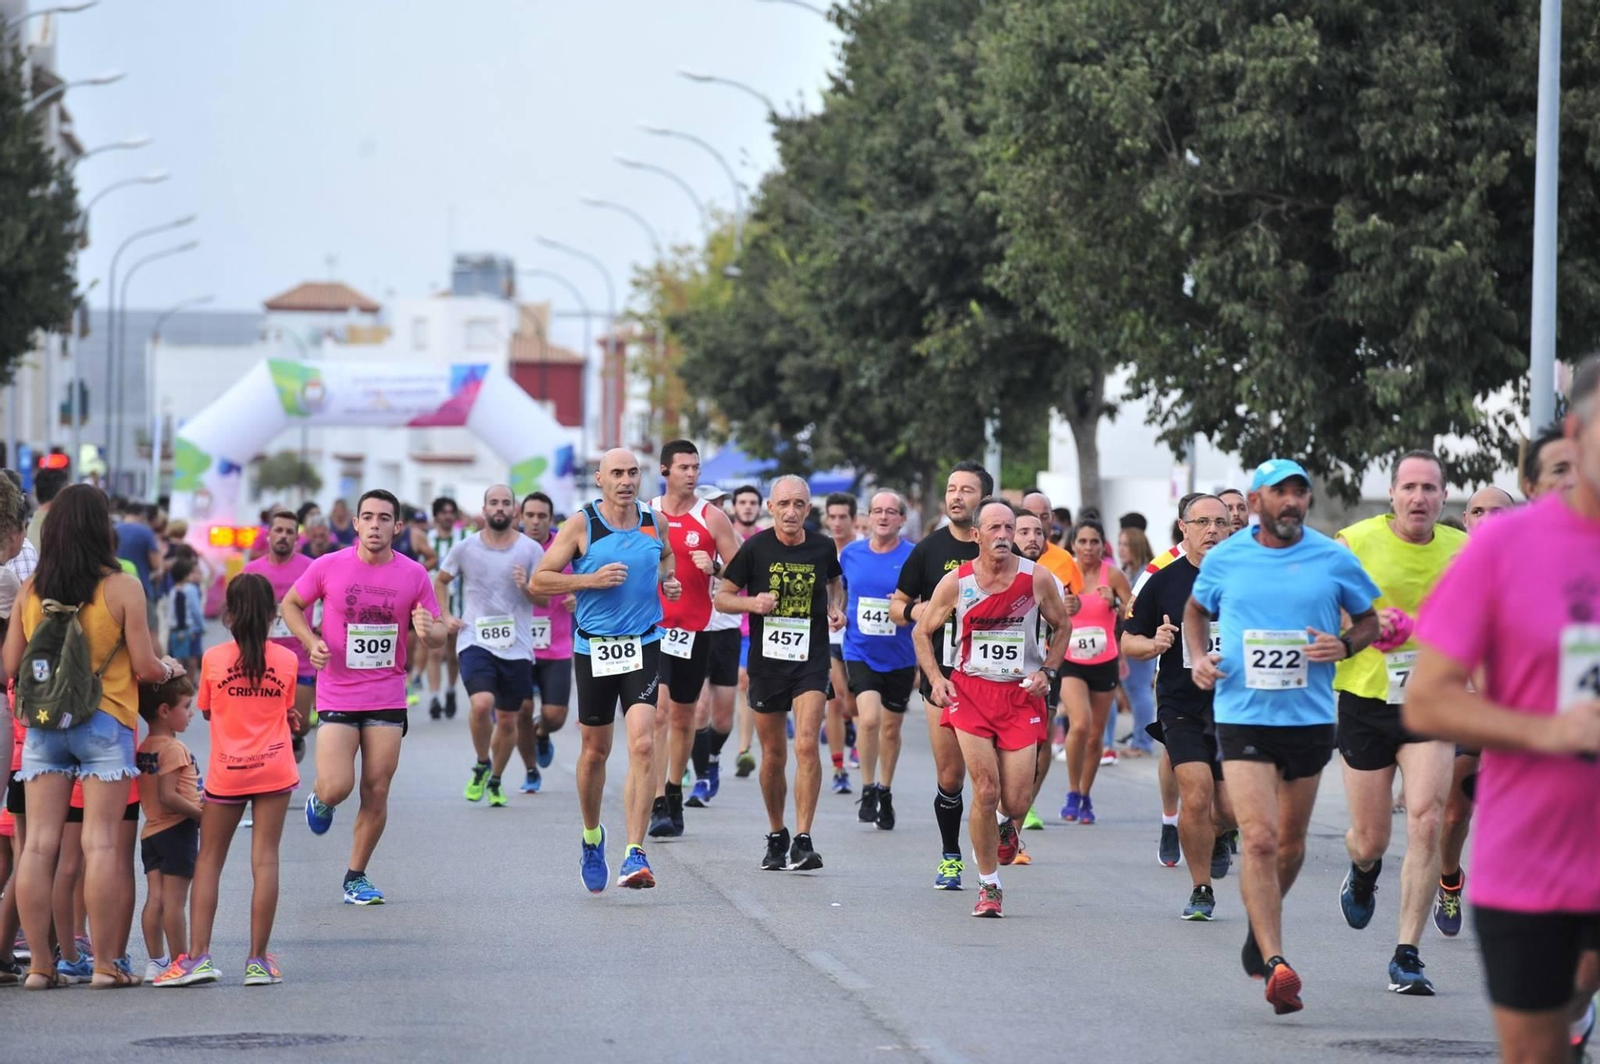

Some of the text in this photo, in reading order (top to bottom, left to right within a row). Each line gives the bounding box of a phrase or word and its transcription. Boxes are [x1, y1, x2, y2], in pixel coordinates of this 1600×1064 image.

[862, 610, 890, 623] 447
[481, 627, 511, 640] 686
[662, 629, 690, 645] 92
[768, 630, 804, 647] 457
[353, 638, 391, 654] 309
[597, 642, 636, 661] 308
[979, 643, 1018, 660] 195
[1078, 637, 1096, 650] 81
[1252, 649, 1301, 669] 222
[228, 686, 282, 698] CRISTINA
